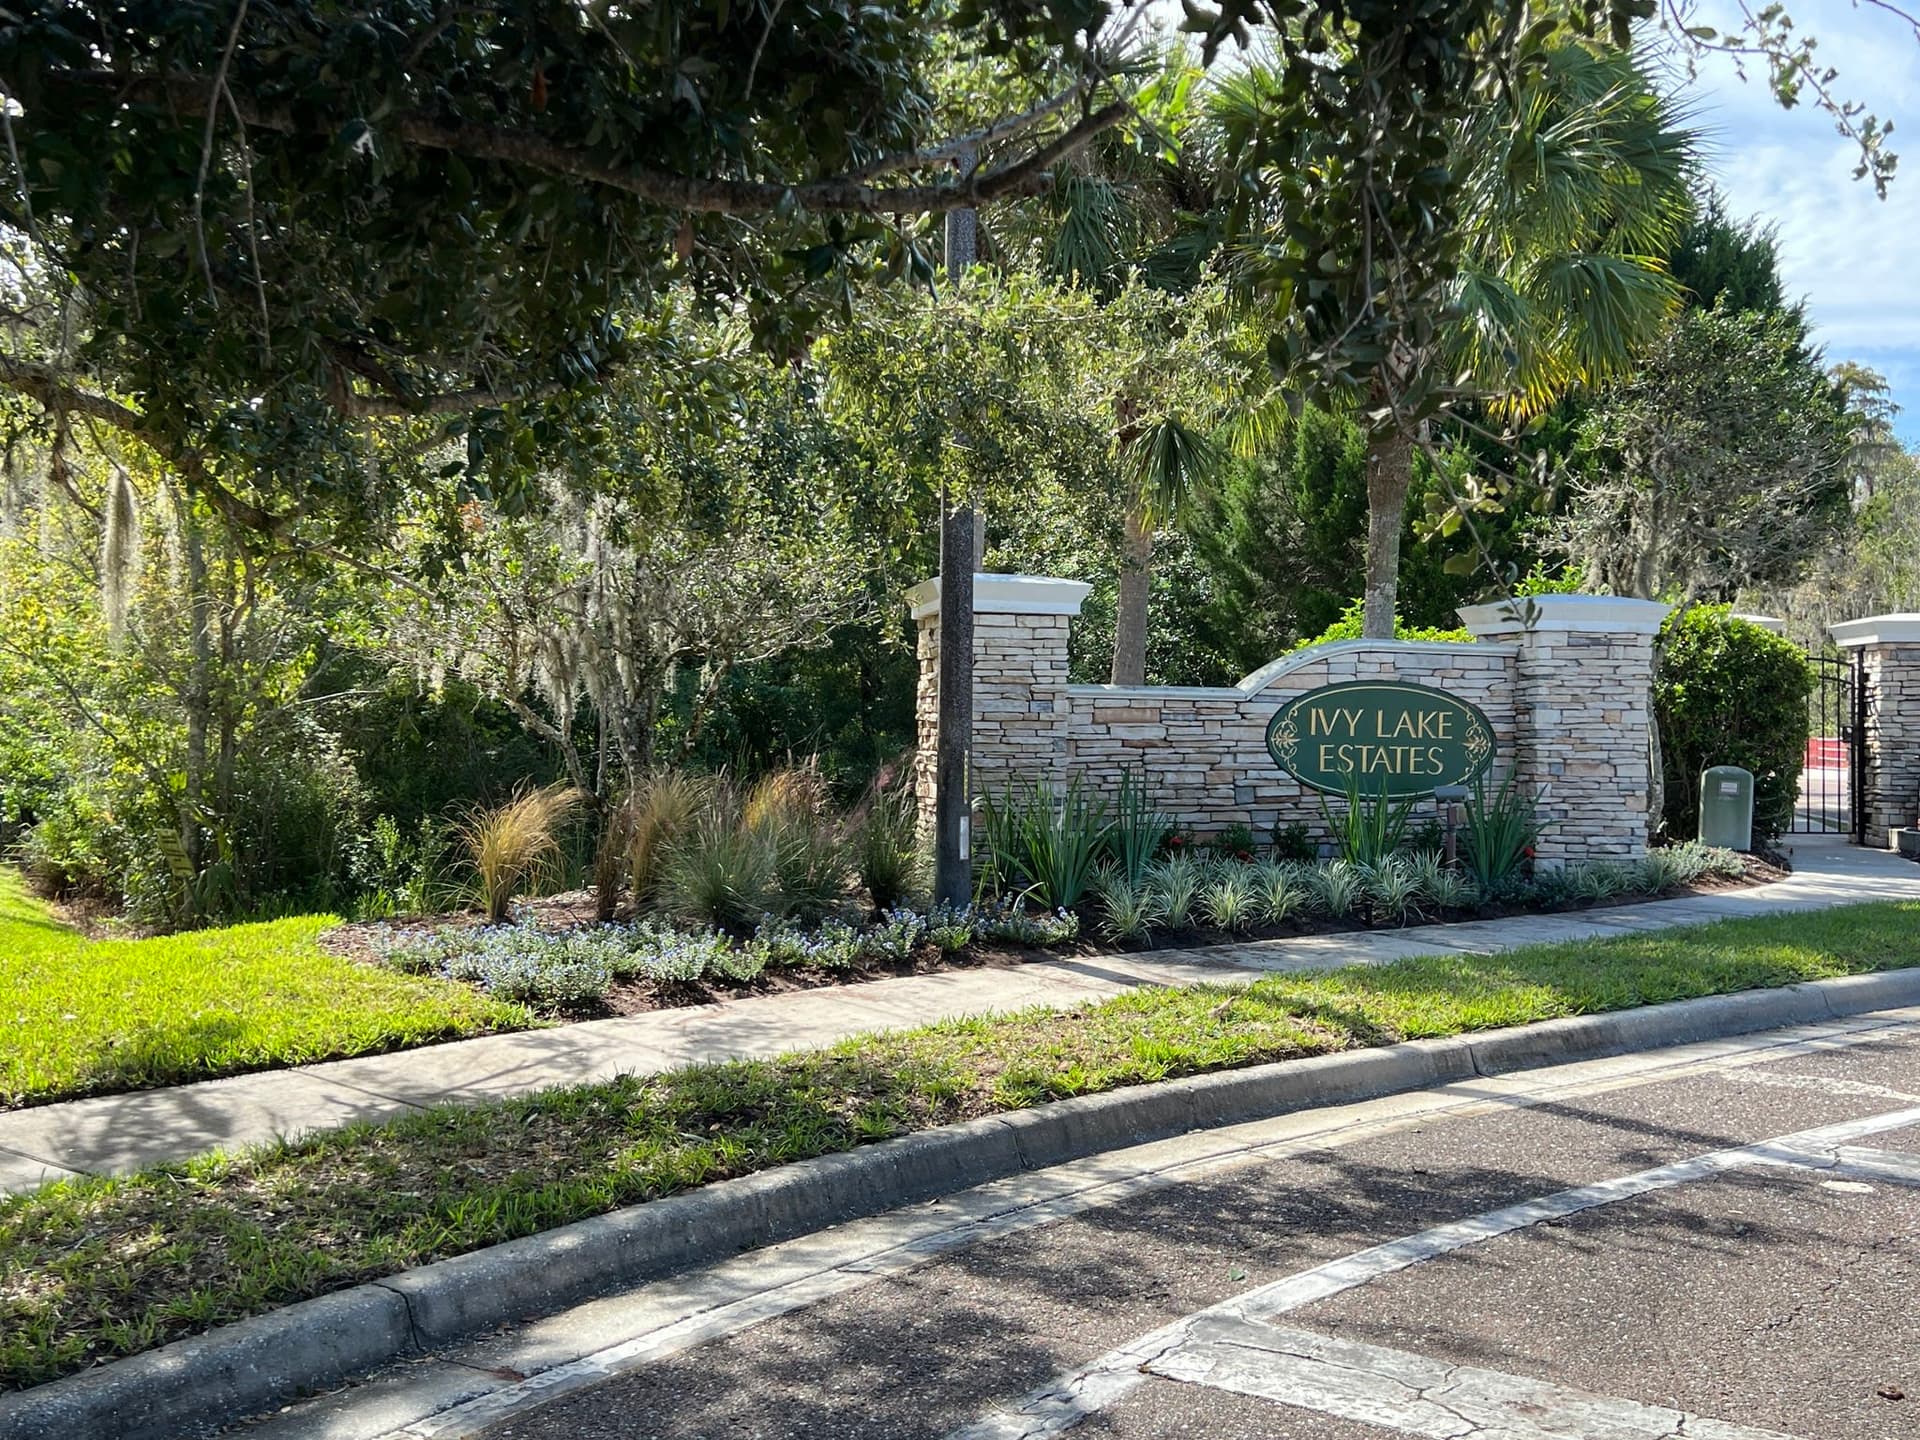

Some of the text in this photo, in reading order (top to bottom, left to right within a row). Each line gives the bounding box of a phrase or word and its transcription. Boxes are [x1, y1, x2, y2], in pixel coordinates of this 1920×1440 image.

[1310, 707, 1453, 739] IVY LAKE
[1319, 744, 1443, 775] ESTATES
